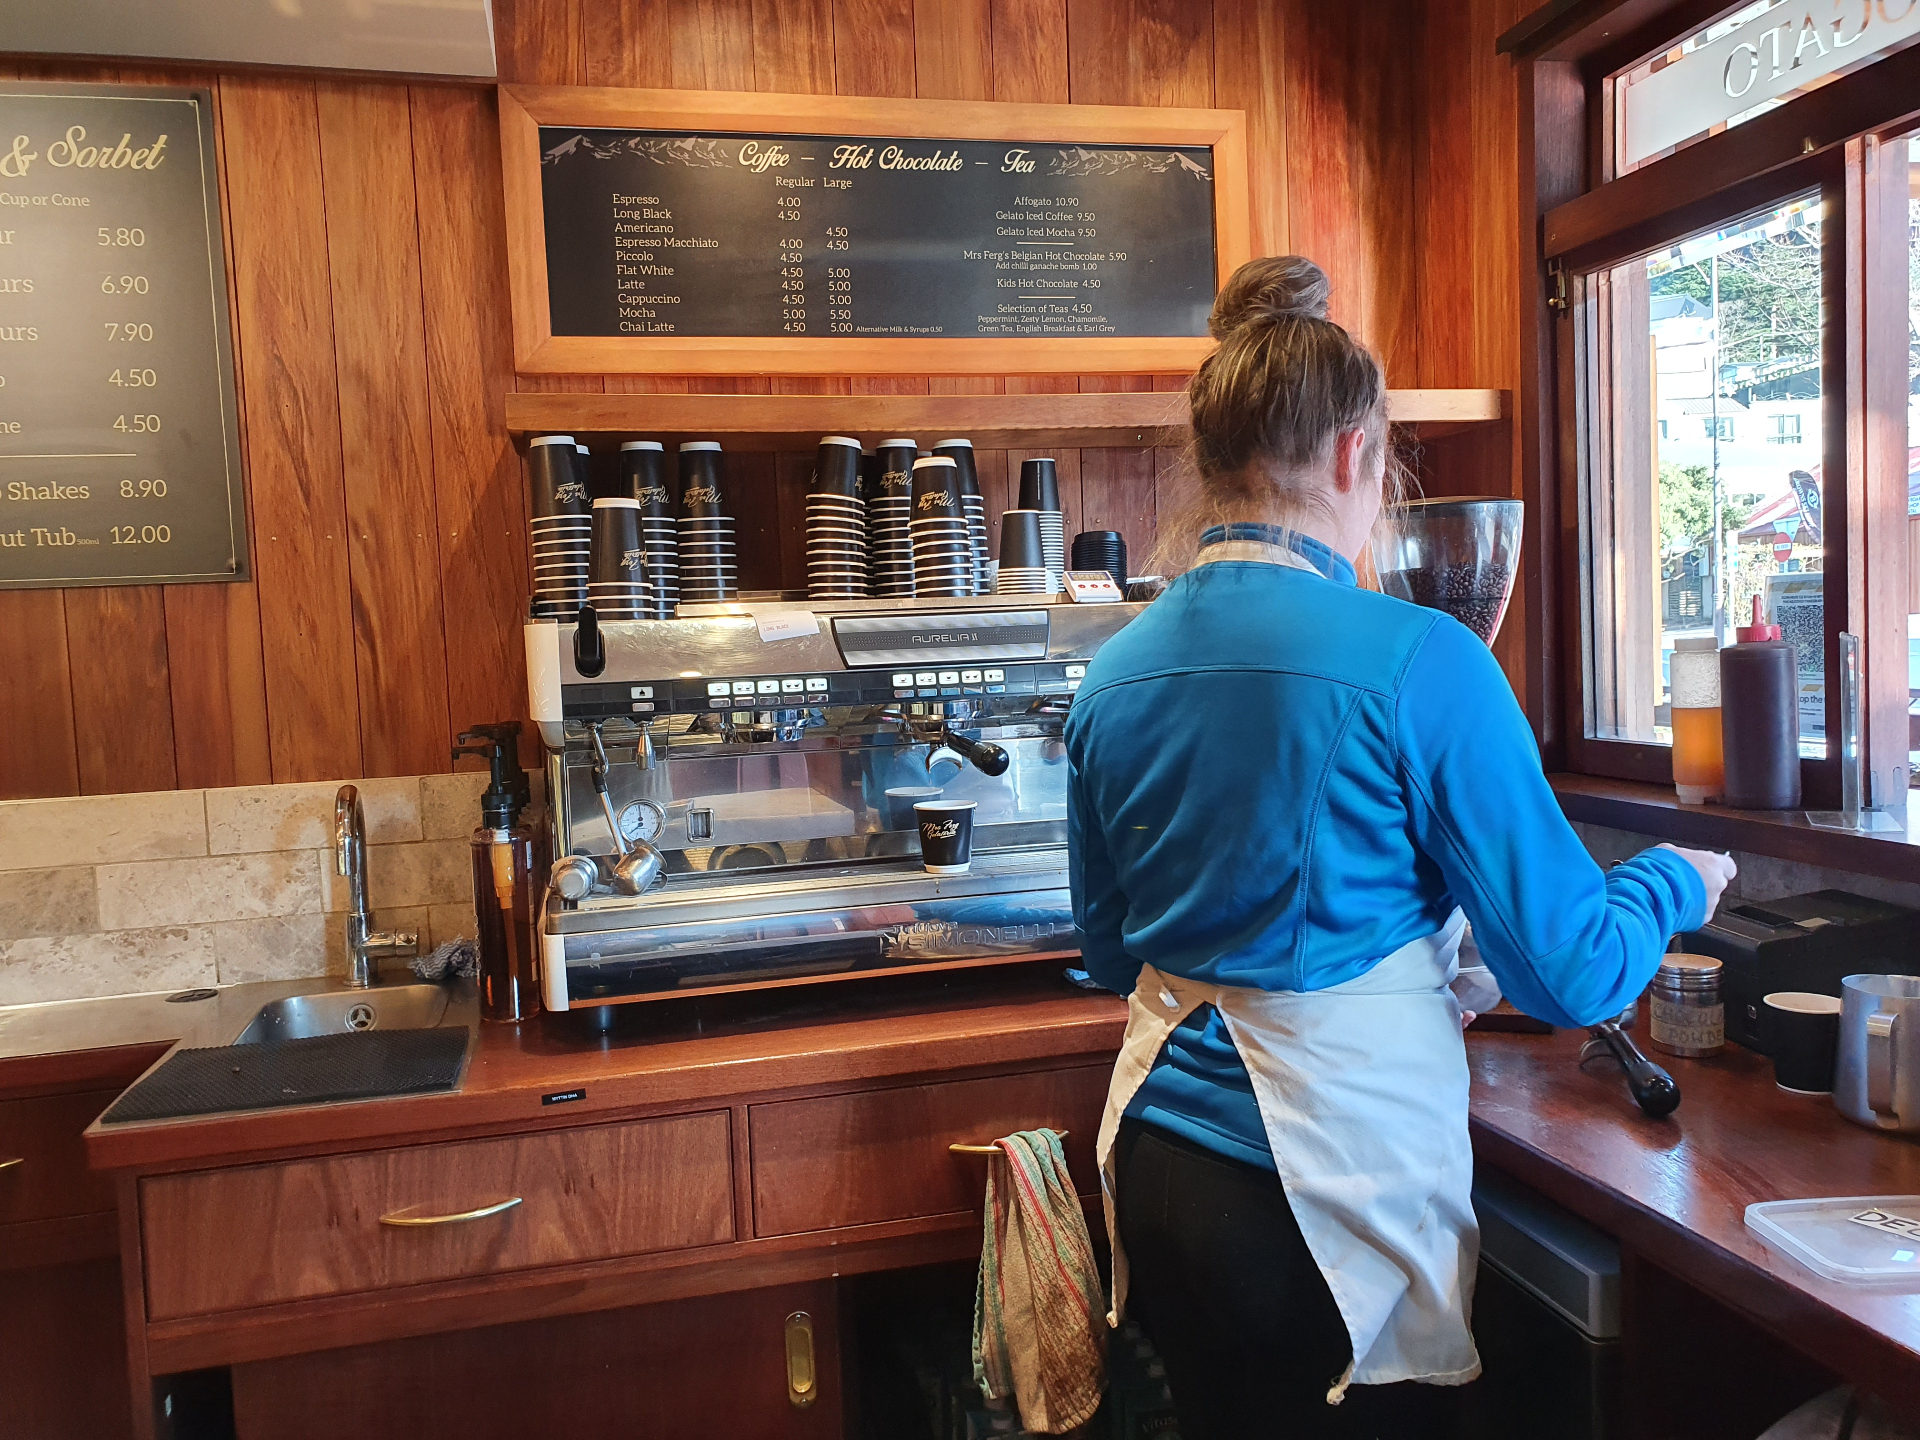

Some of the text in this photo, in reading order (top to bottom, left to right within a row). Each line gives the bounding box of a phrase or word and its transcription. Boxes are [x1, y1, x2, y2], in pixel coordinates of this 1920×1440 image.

[0, 125, 167, 177] & Sorbet
[739, 140, 790, 173] Coffee
[829, 145, 874, 169] Hot
[879, 146, 963, 171] Chocolate
[1001, 149, 1036, 172] Tea
[776, 176, 852, 189] Regular Large
[0, 193, 90, 207] Cup or Cone
[613, 194, 800, 207] Espresso 4.00
[1014, 197, 1078, 207] Affogato 10.90
[614, 208, 800, 220] Long Black 4.50
[996, 211, 1095, 221] Gelato Iced Coffee 9.50
[615, 223, 848, 237] Americano 4.50
[997, 227, 1096, 237] Gelato Iced Mocha 9.50
[98, 228, 145, 246] 5.80
[615, 237, 848, 250] Espresso Macchiato 4.00 4.50
[616, 251, 802, 262] Piccolo 4.50
[964, 251, 1126, 261] Mrs Ferg's Belgian Hot Chocolate 5.90
[617, 265, 850, 278] Flat White 4.50 5.00
[996, 262, 1012, 270] Add
[1030, 261, 1058, 271] ganache
[1060, 262, 1079, 270] bomb
[102, 276, 149, 294] 6.90
[618, 279, 850, 291] Latte 4.50 5.00
[997, 279, 1100, 288] Kids Hot Chocolate 4.50
[618, 294, 851, 305] Cappuccino 4.50 5.00
[619, 308, 851, 319] Mocha 5.00 5.50
[998, 304, 1092, 313] Selection of Teas 4.50
[978, 316, 1020, 324] Peppermint,
[1020, 316, 1039, 324] Zesty
[1068, 316, 1107, 324] Chamomile,
[105, 323, 153, 341] 7.90
[620, 322, 852, 332] Chai Latte 4.50 5.00
[1017, 325, 1041, 334] English
[1044, 325, 1075, 333] Breakfast
[1084, 325, 1100, 333] Earl
[1100, 325, 1115, 334] Grey
[109, 369, 156, 387] 4.50
[113, 415, 160, 432] 4.50
[8, 481, 89, 500] Shakes
[121, 480, 167, 497] 8.90
[30, 527, 76, 546] Tub
[110, 525, 170, 544] 12.00
[912, 633, 970, 644] AURELIA
